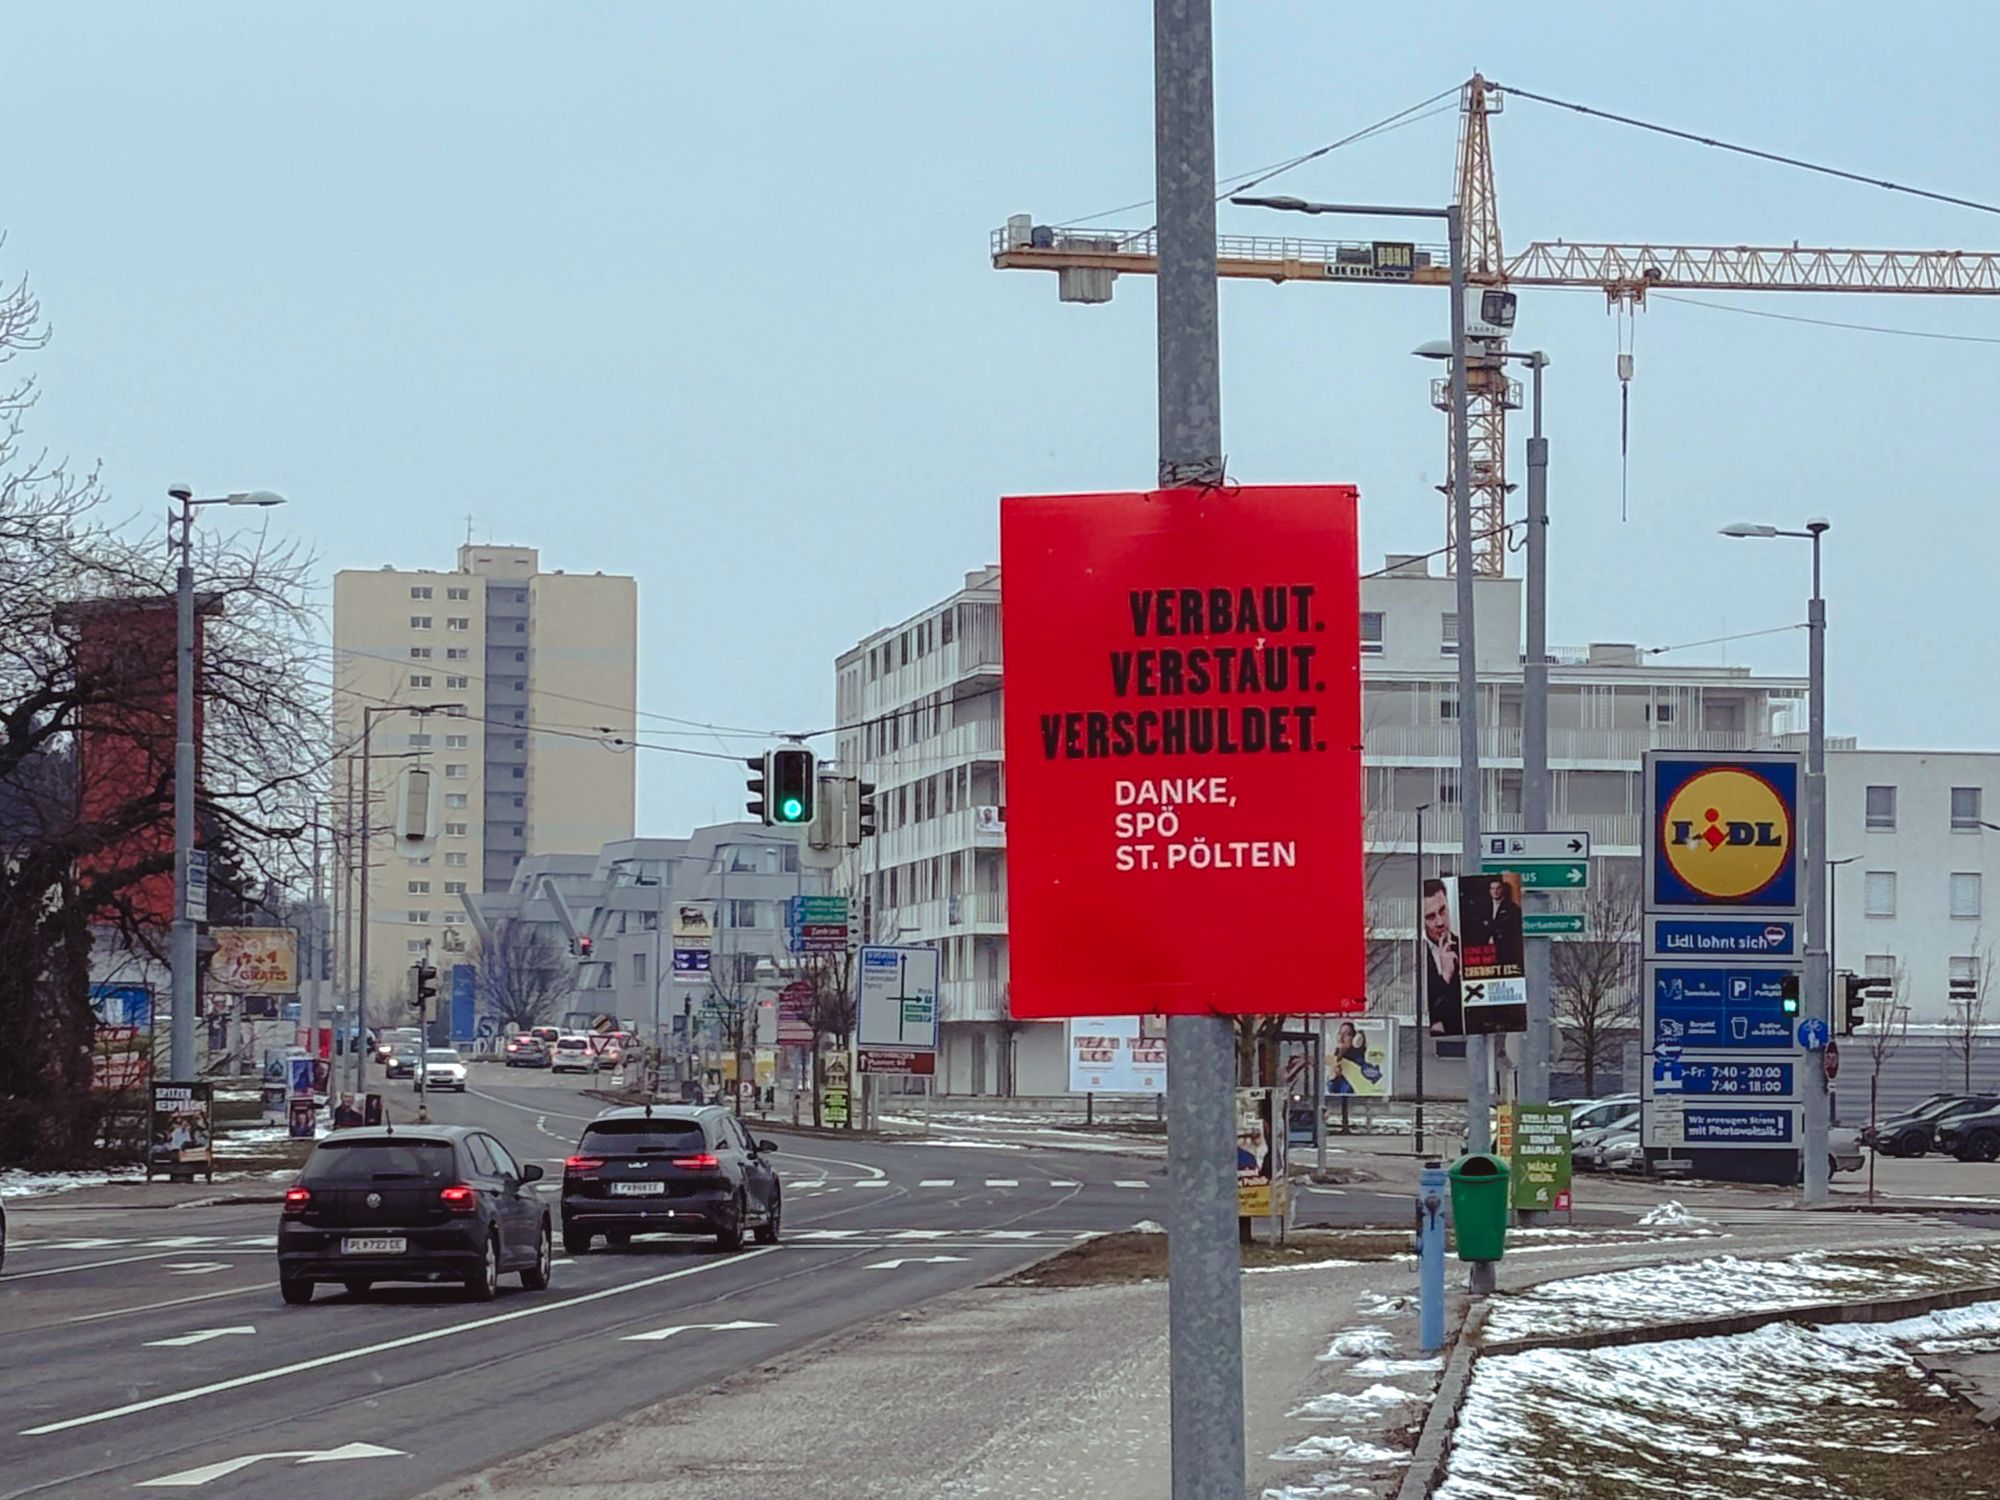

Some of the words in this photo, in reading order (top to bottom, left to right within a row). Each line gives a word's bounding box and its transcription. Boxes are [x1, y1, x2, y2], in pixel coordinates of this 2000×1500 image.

[1129, 585, 1326, 637] VERBAUT.
[1110, 646, 1326, 697] VERSTAUT.
[1040, 706, 1327, 760] VERSCHULDET.
[1115, 777, 1237, 808] DANKE,
[1115, 805, 1179, 838] SPÖ
[1115, 844, 1159, 871] ST.
[1168, 836, 1297, 870] PÖLTEN
[1667, 934, 1694, 948] Lidl
[1698, 935, 1735, 949] lohnt
[1738, 936, 1768, 950] sich
